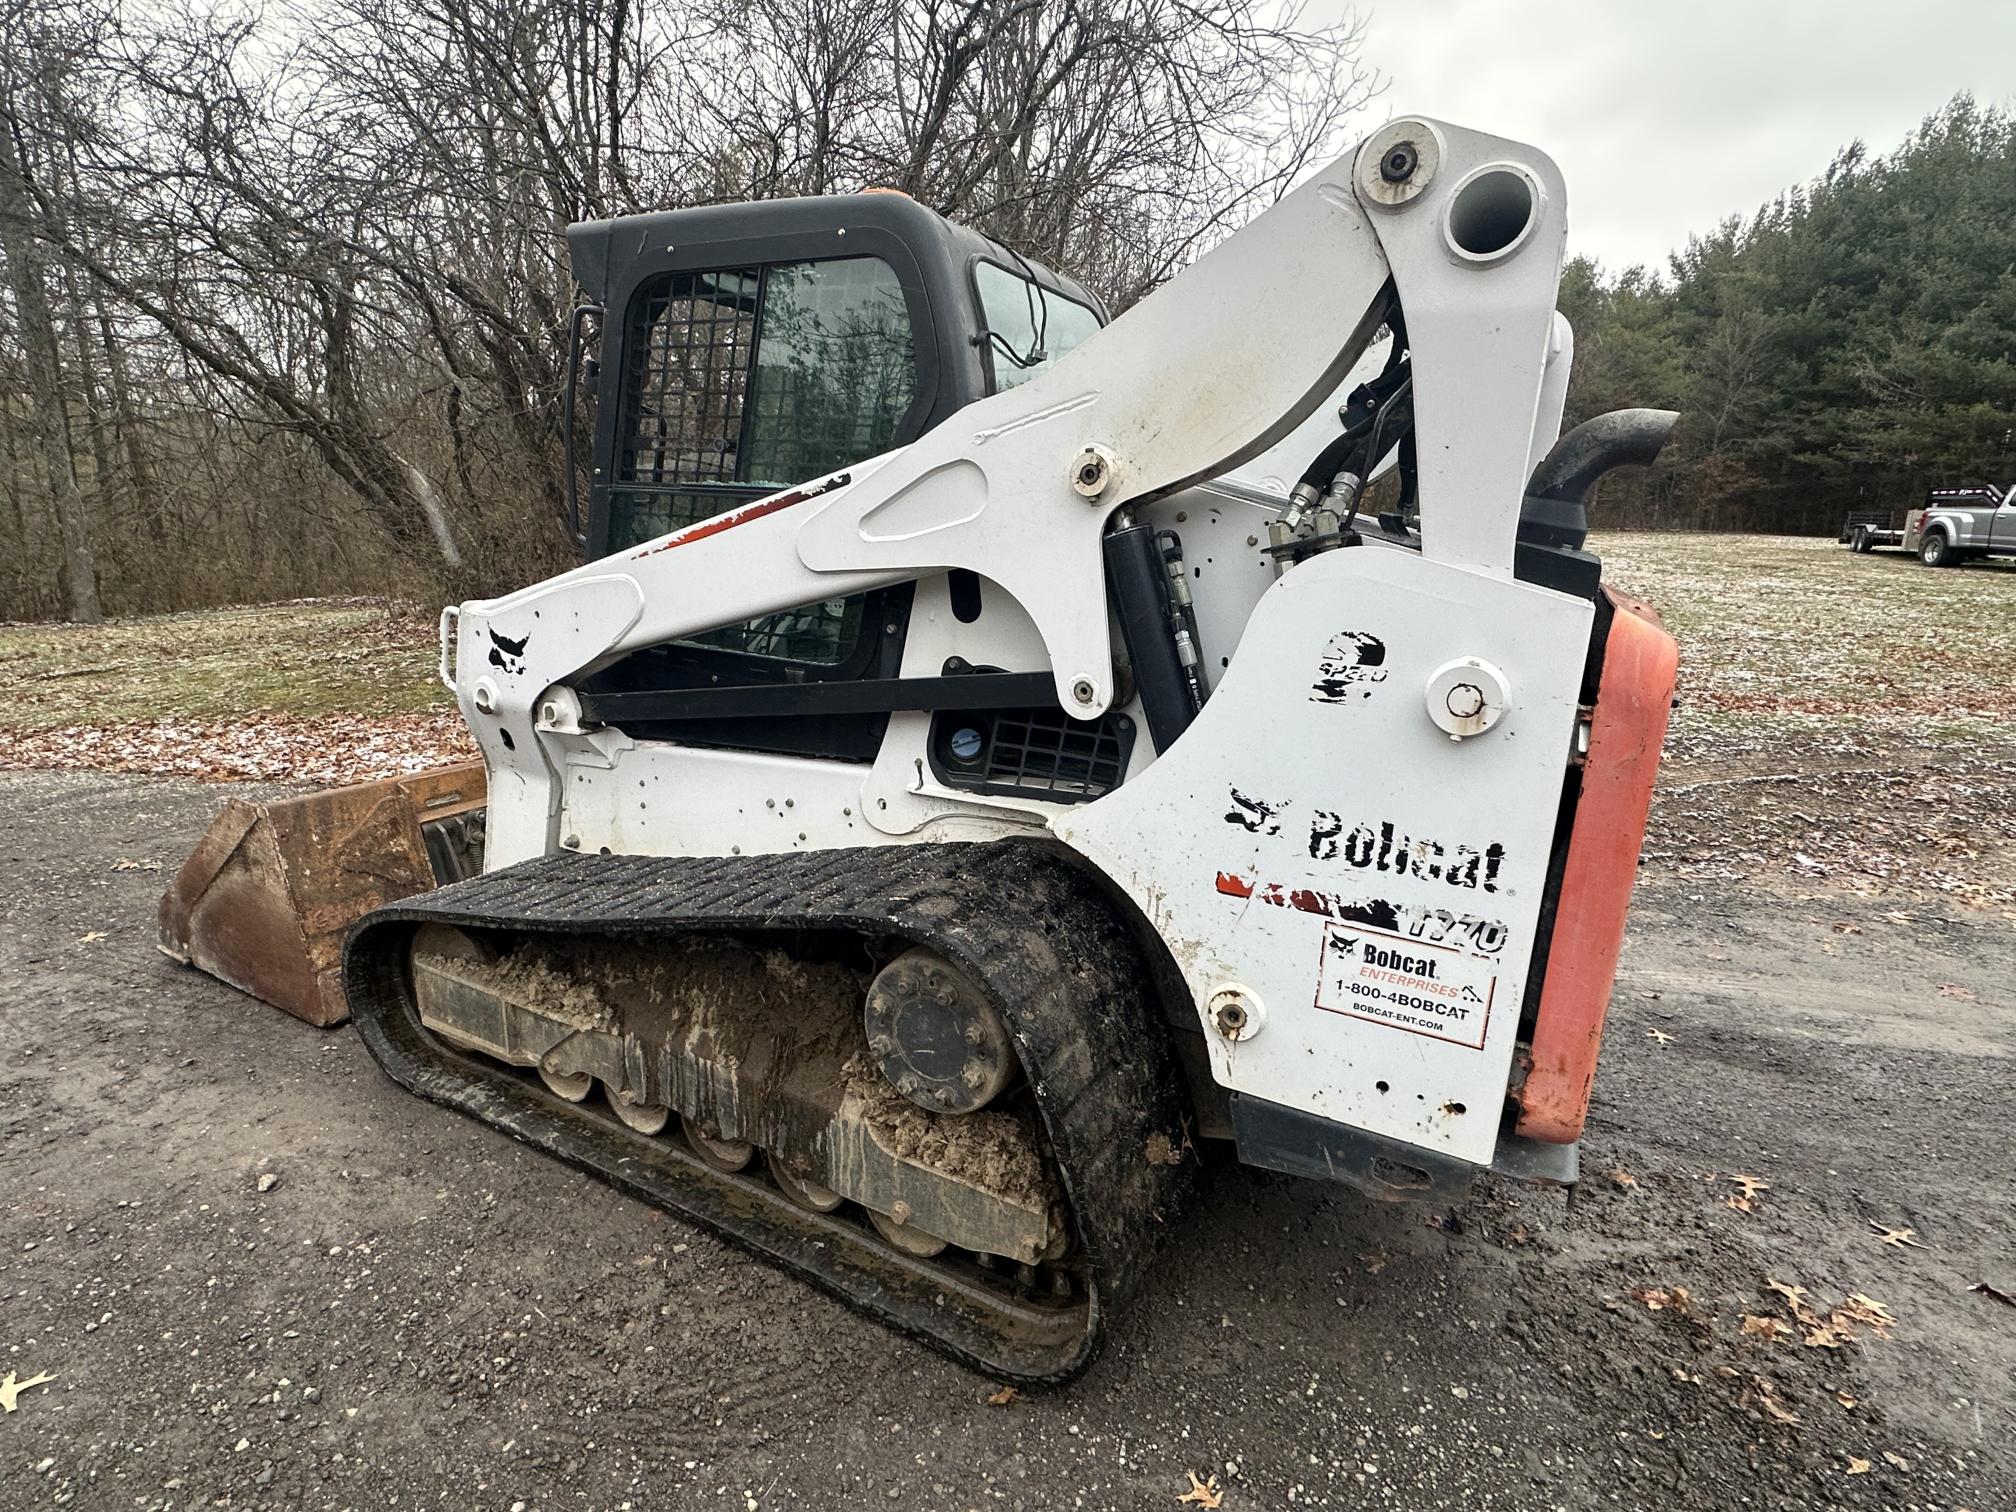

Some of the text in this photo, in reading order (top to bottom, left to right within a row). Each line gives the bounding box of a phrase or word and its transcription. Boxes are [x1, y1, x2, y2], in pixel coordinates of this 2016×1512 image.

[1363, 943, 1437, 979] Bobcat
[1359, 966, 1459, 998] ENTERPRISES
[1336, 979, 1470, 1021] 1-800-4BOBCAT
[1353, 1002, 1443, 1031] BOBCAT-ENT.COM
